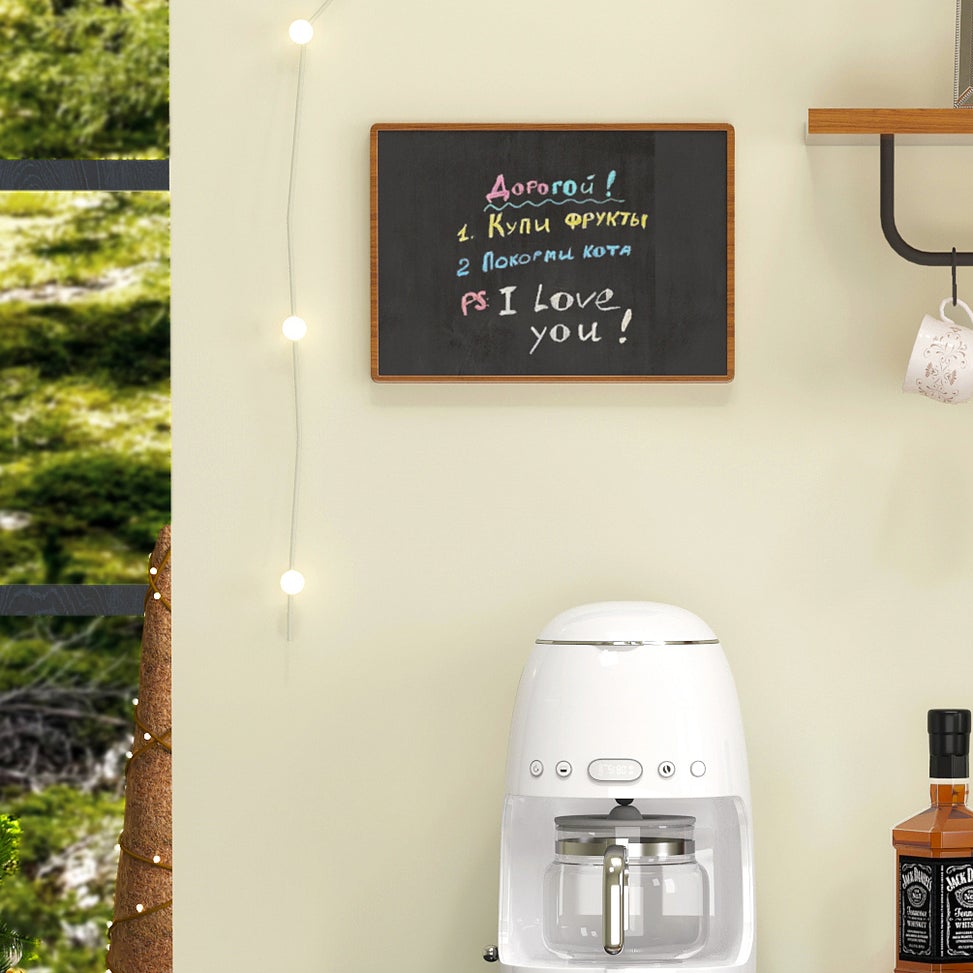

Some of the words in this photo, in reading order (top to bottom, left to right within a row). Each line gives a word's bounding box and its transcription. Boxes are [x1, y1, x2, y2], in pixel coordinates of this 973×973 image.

[457, 223, 474, 242] 1.
[488, 212, 550, 239] Купи
[456, 258, 470, 277] 2
[482, 248, 574, 273] Покорми
[499, 286, 517, 316] I
[534, 283, 621, 312] Love
[946, 872, 967, 892] JACK
